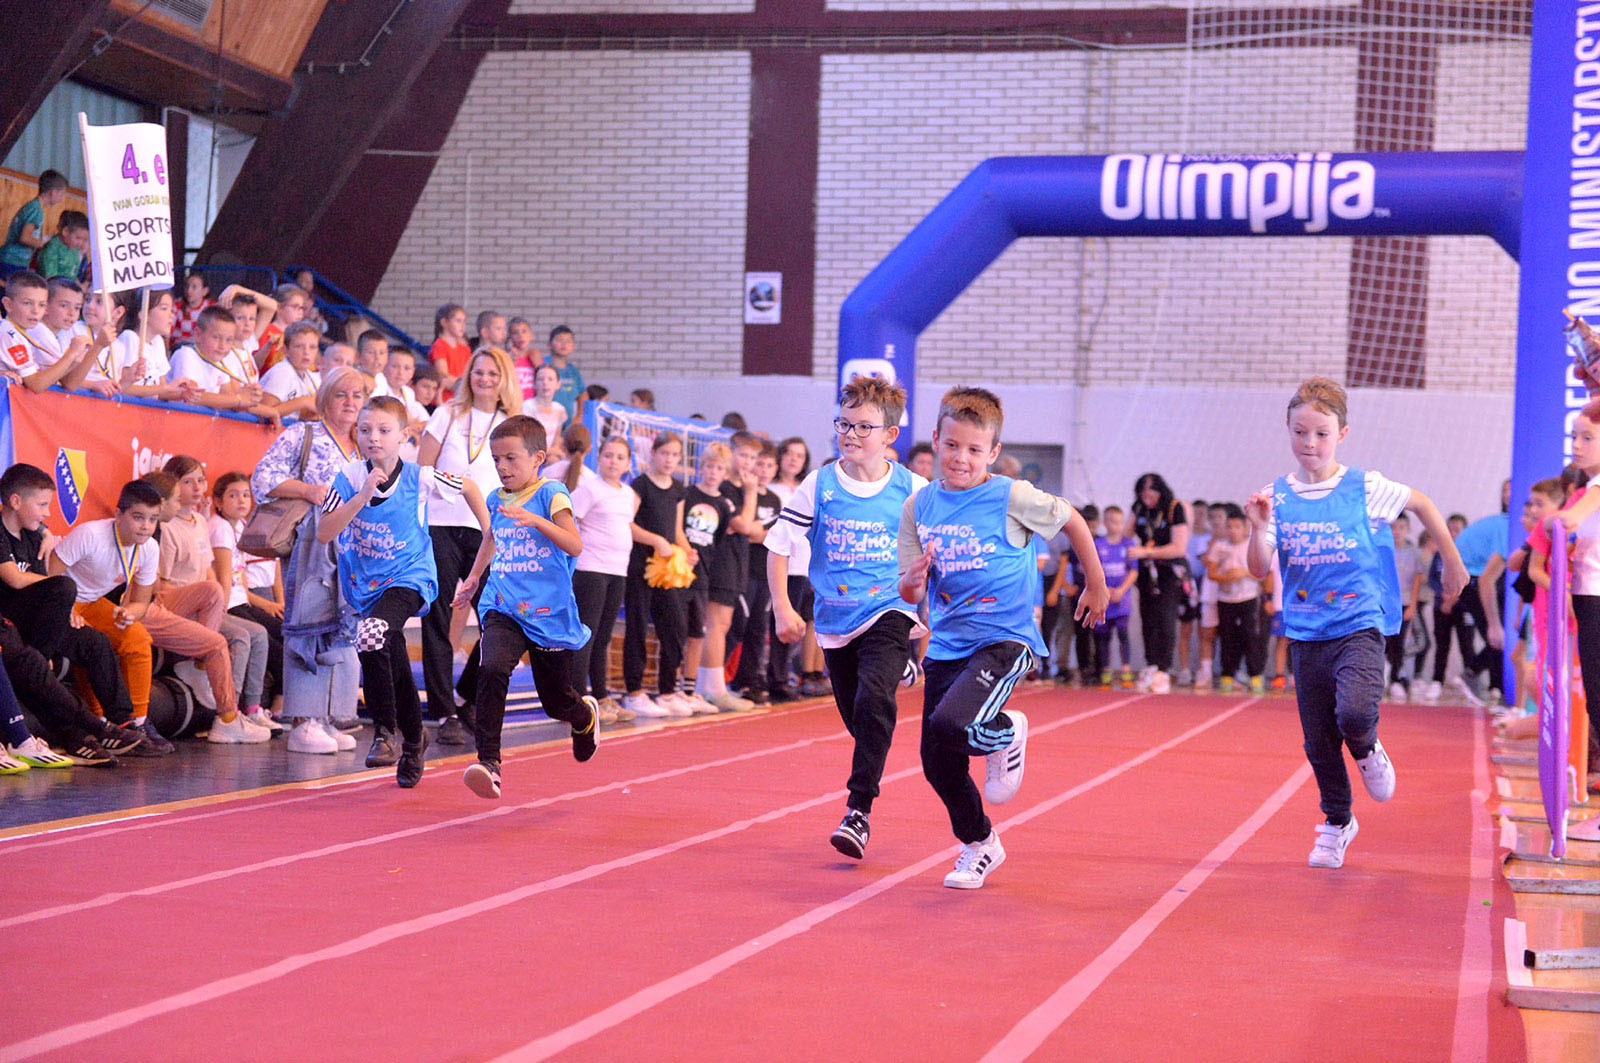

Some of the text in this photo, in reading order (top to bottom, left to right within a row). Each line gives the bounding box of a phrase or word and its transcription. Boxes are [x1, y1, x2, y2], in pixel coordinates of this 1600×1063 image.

[1568, 0, 1600, 250] MINISTARSTV
[121, 143, 166, 186] 4. e
[1101, 154, 1375, 233] Olimpija
[108, 239, 152, 263] IGRE
[113, 260, 173, 284] MLADI
